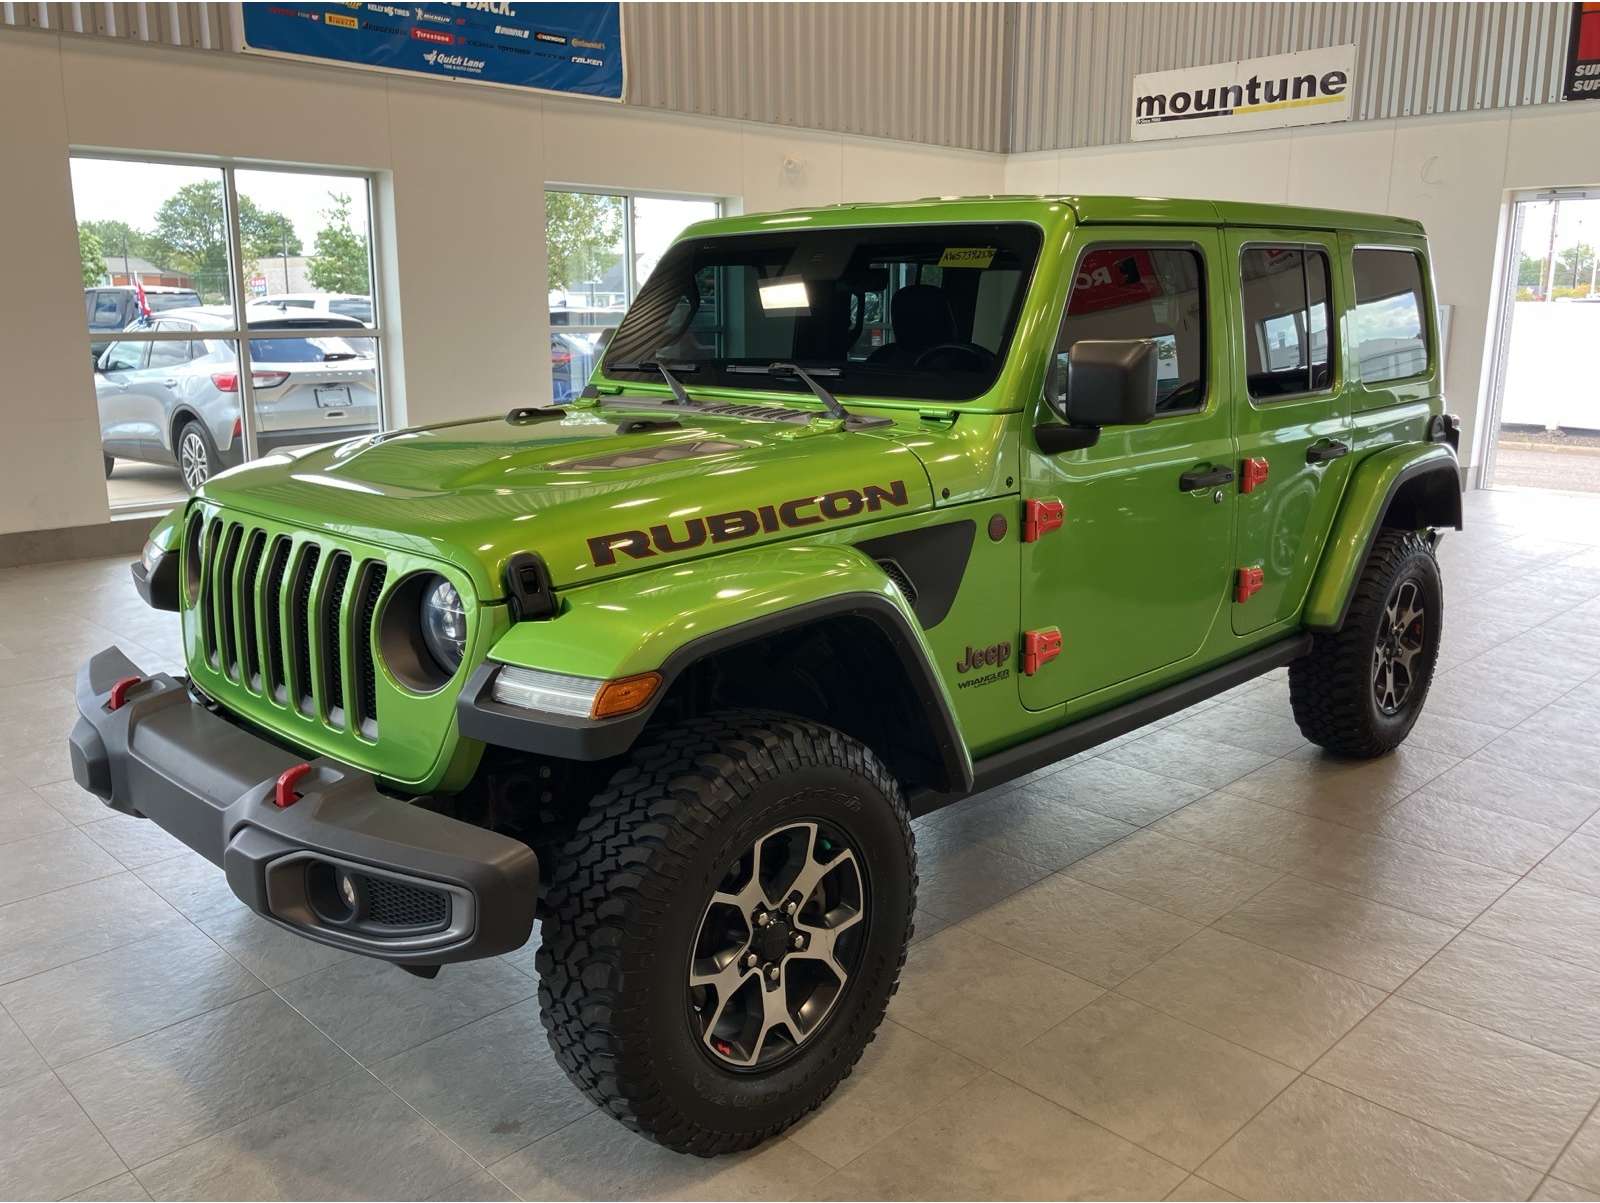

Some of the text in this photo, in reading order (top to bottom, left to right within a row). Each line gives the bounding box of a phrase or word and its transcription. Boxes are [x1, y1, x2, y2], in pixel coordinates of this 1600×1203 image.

[437, 53, 485, 68] Quick Lane
[1136, 70, 1347, 117] mountune
[586, 480, 909, 567] RUBICON
[956, 641, 1011, 673] Jeep
